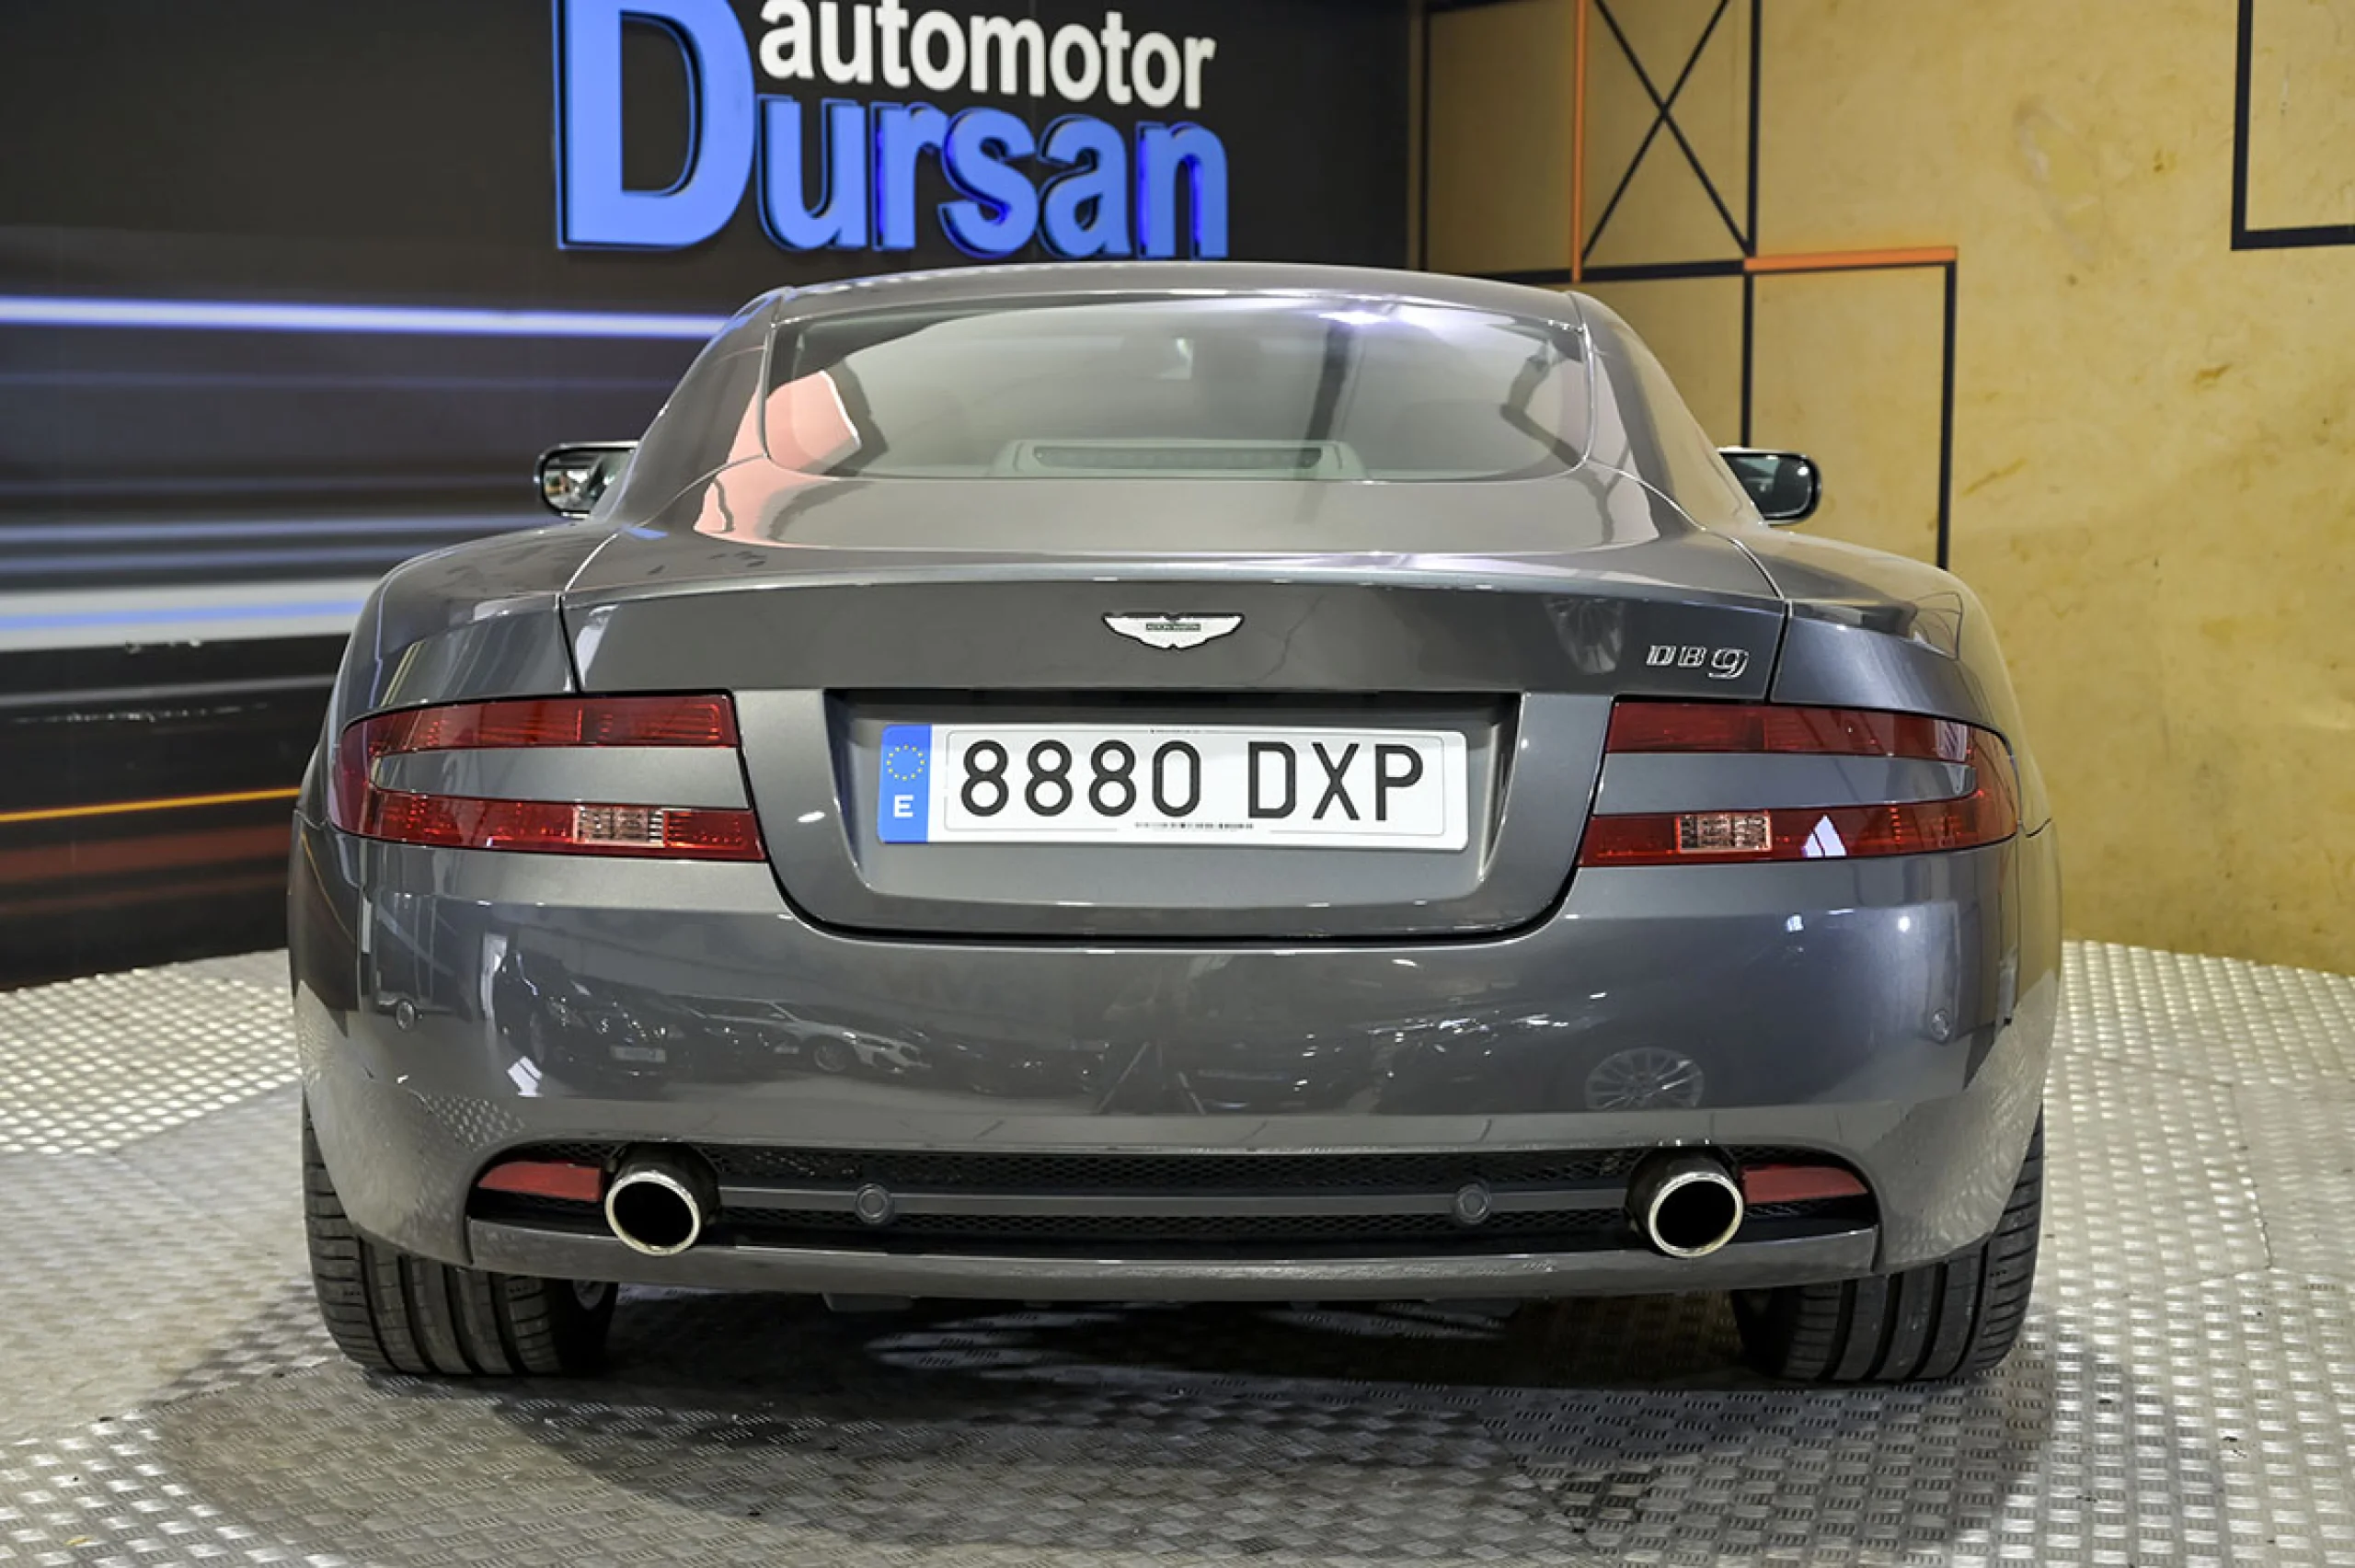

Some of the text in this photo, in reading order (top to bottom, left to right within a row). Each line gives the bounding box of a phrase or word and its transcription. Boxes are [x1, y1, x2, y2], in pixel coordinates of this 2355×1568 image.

[759, 0, 1217, 109] automotor
[557, 0, 1229, 260] Dursan
[1646, 645, 1750, 679] DB9
[893, 795, 914, 818] E
[960, 739, 1424, 821] 8880 DXP
